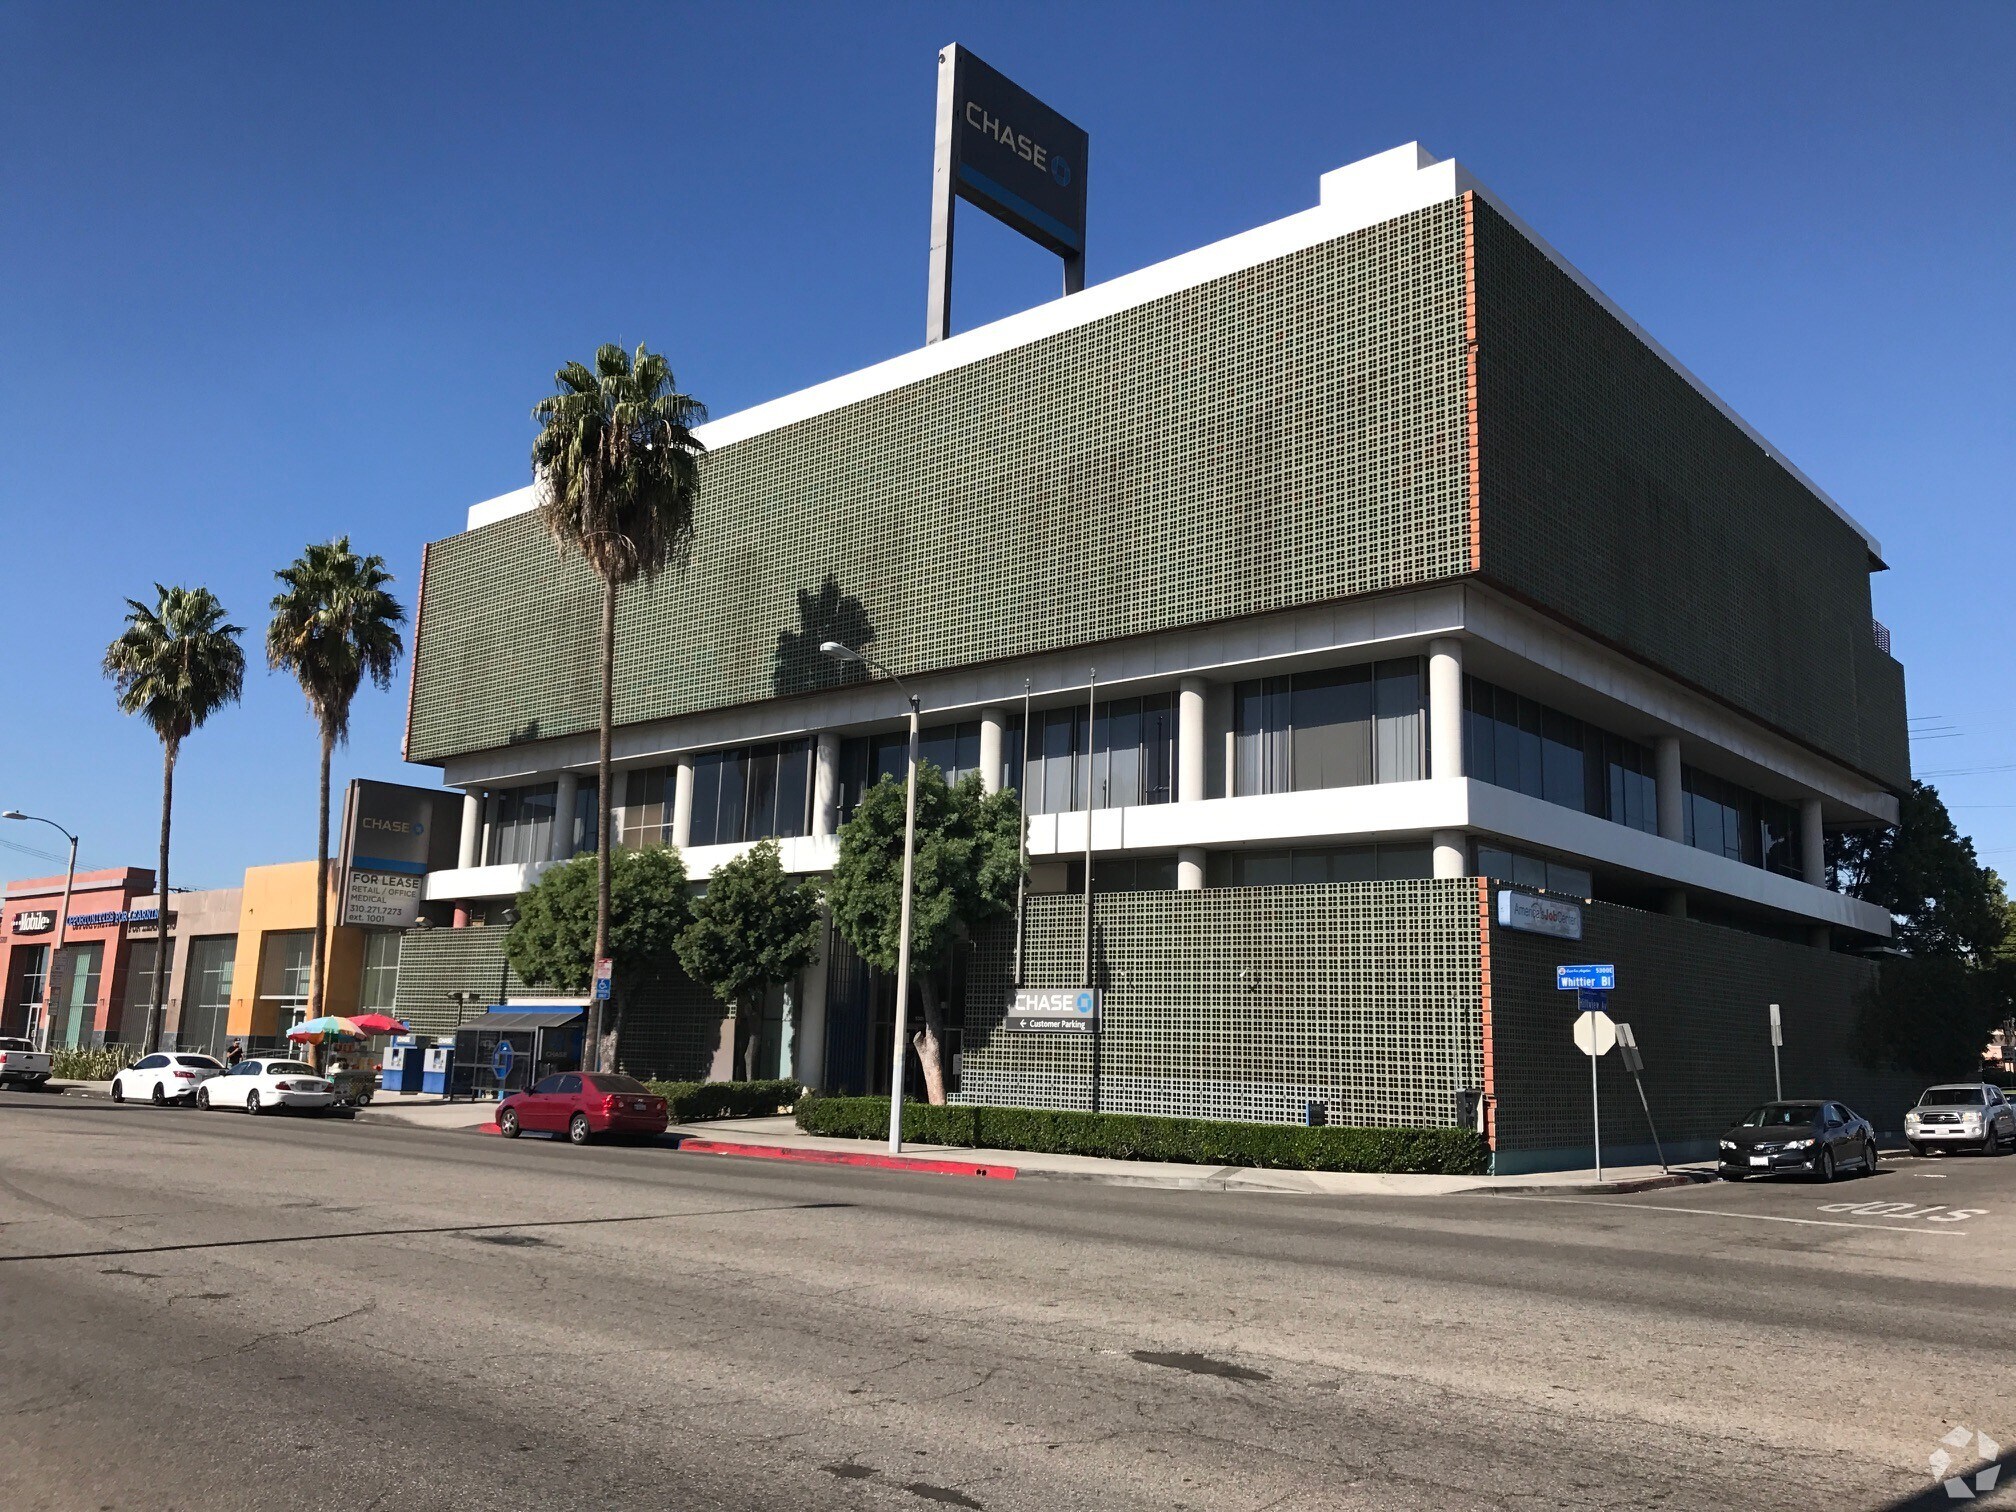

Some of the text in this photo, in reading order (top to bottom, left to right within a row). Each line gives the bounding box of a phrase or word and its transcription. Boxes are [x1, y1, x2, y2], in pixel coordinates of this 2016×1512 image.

[966, 101, 1047, 172] CHASE
[362, 817, 410, 834] CHASE
[353, 873, 419, 889] FOR LEASE
[352, 885, 380, 895] RETAIL
[388, 889, 416, 898] OFFICE
[351, 894, 387, 904] MEDICAL
[350, 905, 402, 916] 310.271.7273
[367, 914, 385, 923] 1001
[1561, 976, 1611, 987] Whittier Bl
[1015, 994, 1073, 1011] CHASE
[1029, 1019, 1086, 1030] Customer Parking
